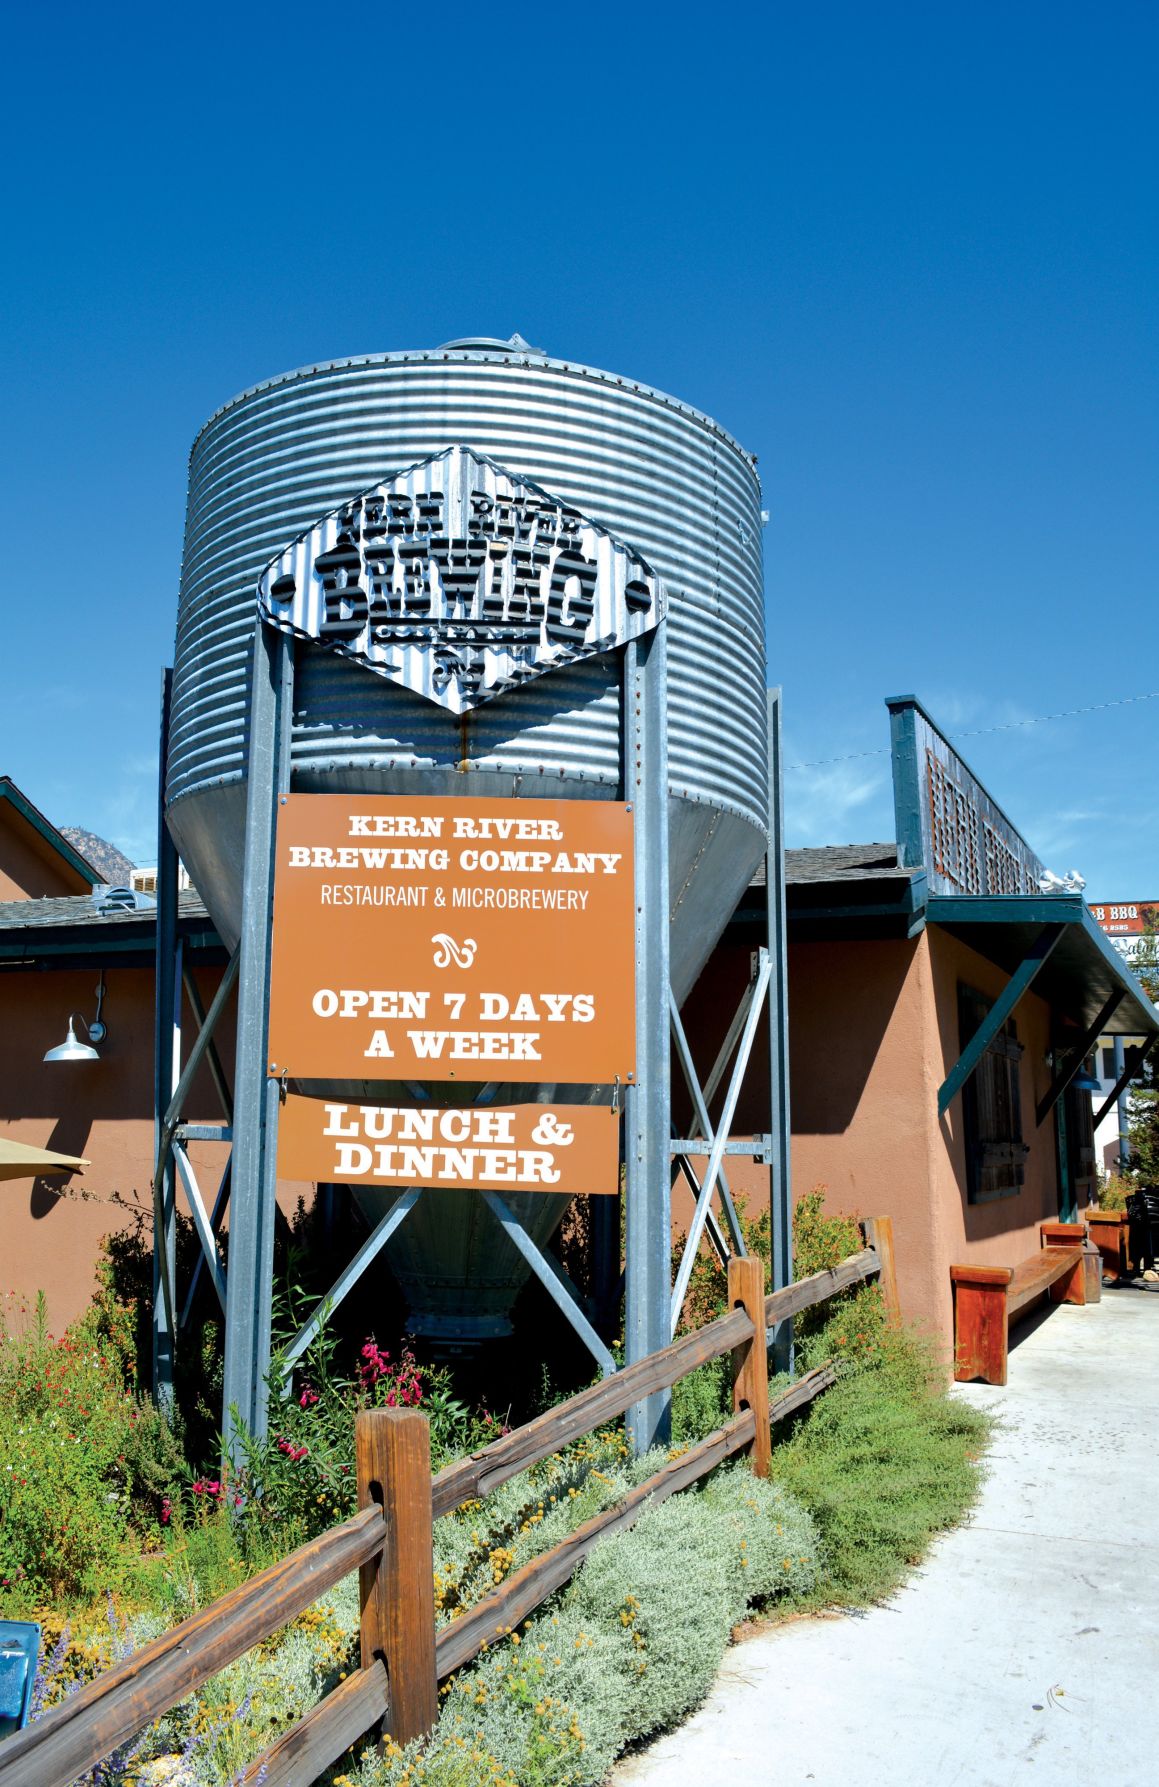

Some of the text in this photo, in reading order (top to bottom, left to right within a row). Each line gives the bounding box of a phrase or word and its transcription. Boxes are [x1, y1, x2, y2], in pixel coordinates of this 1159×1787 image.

[336, 489, 584, 553] KERN RIVER
[314, 537, 599, 643] BREWING
[376, 624, 534, 639] COMPANY
[348, 815, 564, 841] KERN RIVER
[288, 846, 623, 875] BREWING COMPANY
[320, 884, 590, 910] RESTAURANT & MICROBREWERY
[1110, 905, 1138, 920] BBQ
[312, 988, 596, 1023] OPEN 7 DAYS
[363, 1029, 542, 1061] A WEEK
[322, 1104, 575, 1146] LUNCH &
[333, 1141, 561, 1184] DINNER
